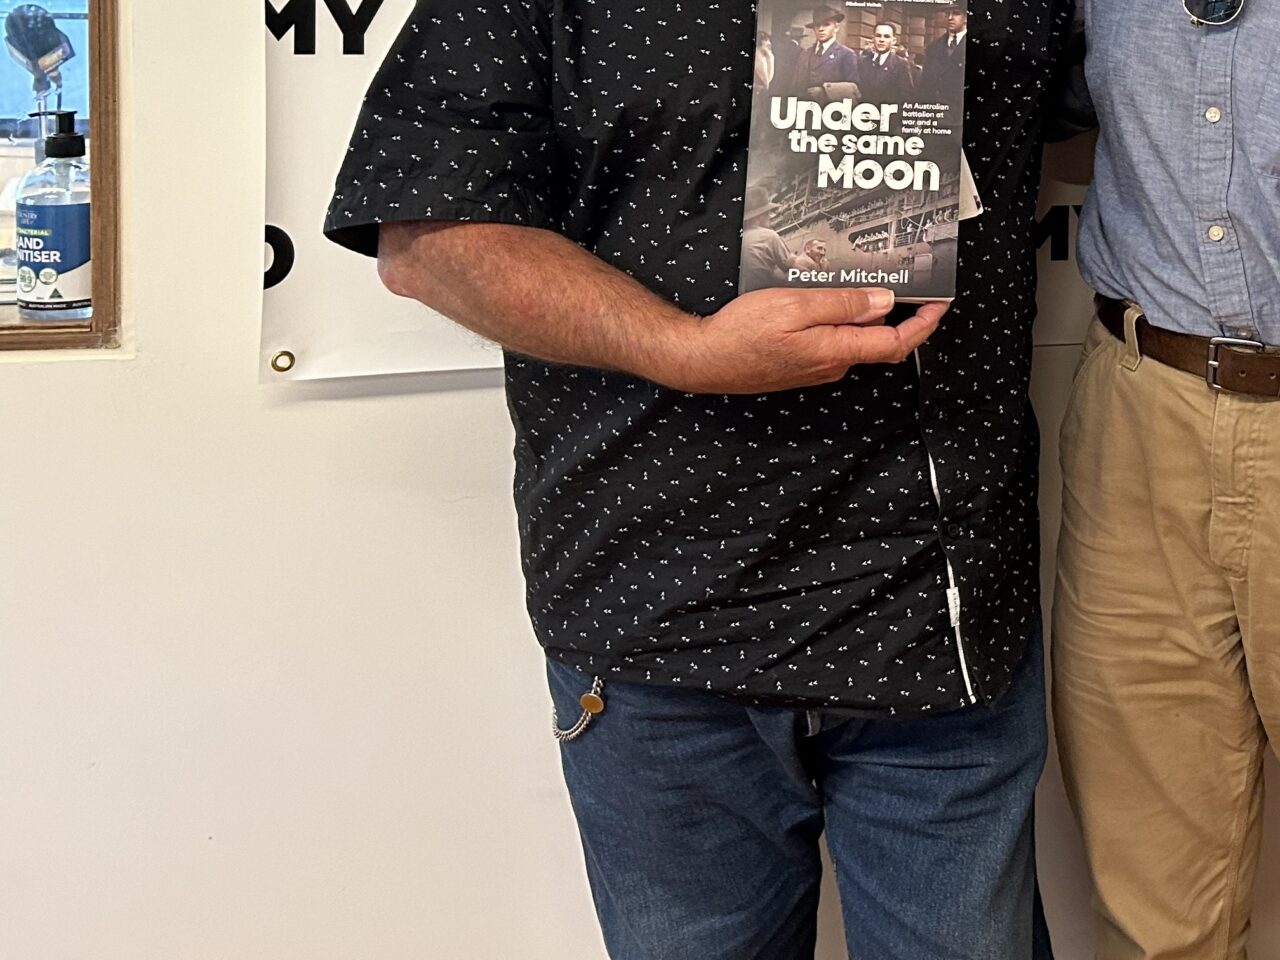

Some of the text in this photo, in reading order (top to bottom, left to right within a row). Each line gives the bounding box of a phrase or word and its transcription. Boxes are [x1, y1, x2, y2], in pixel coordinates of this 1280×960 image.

[902, 110, 935, 118] battalion
[914, 102, 949, 110] Australian
[770, 96, 899, 133] Under
[901, 126, 922, 135] family
[932, 127, 952, 135] home
[788, 130, 925, 156] the same
[817, 153, 940, 191] Moon
[788, 268, 909, 284] Peter Mitchell
